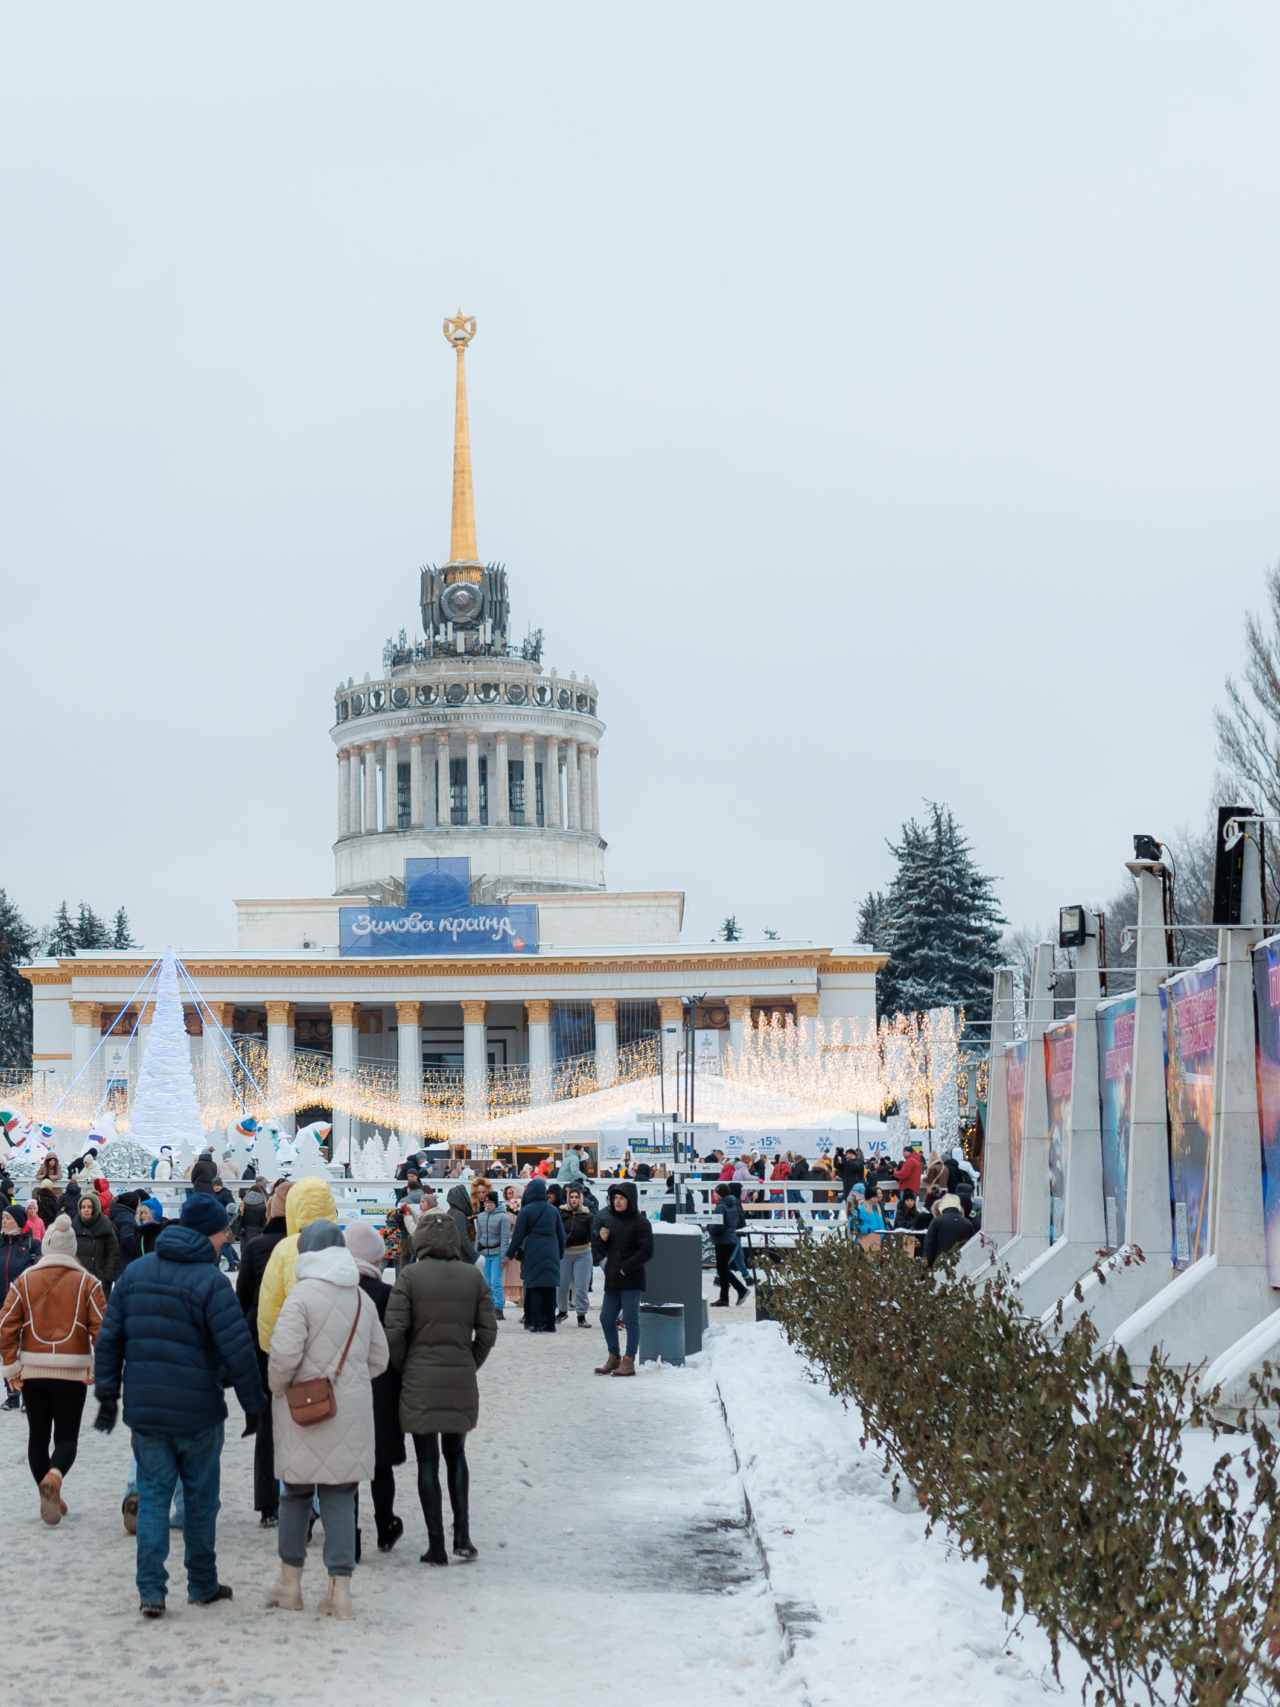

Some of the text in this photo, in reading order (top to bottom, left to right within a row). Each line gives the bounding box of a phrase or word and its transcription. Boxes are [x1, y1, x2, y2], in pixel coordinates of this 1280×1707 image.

[352, 912, 436, 935] Зимова
[725, 1135, 745, 1146] -5%
[757, 1136, 781, 1146] -15%
[867, 1141, 887, 1151] VIS
